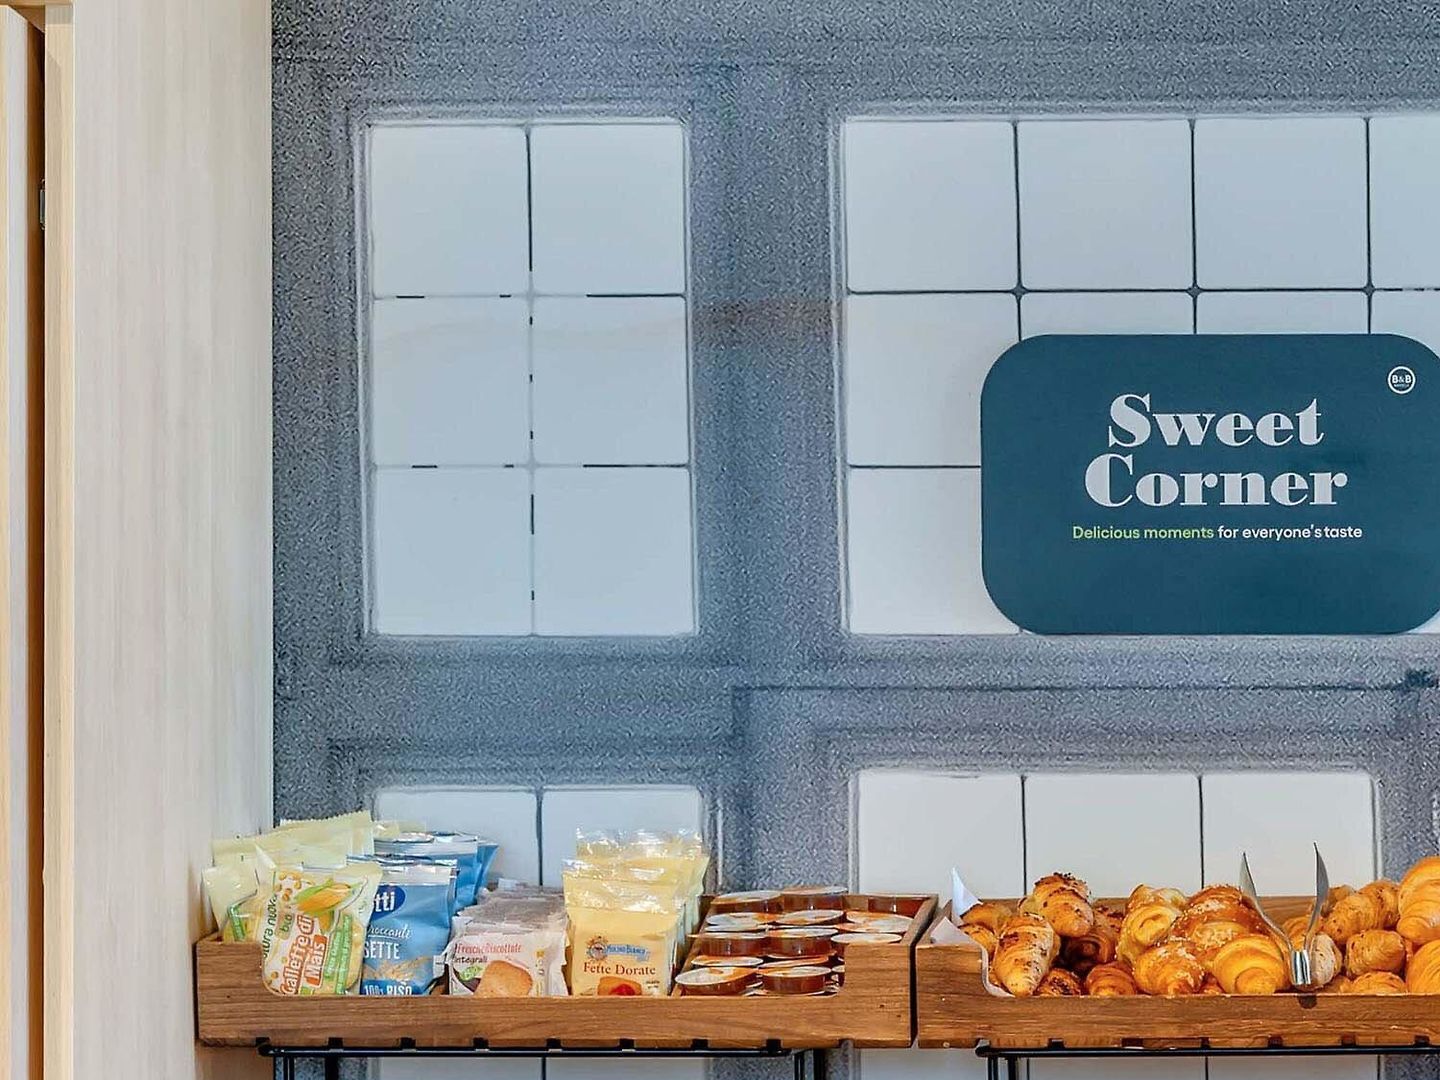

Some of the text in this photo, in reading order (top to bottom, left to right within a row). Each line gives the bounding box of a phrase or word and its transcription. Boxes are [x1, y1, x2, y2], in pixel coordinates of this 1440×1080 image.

[1392, 374, 1411, 383] B&B
[1108, 393, 1324, 448] Sweet
[1085, 453, 1348, 507] Corner
[1072, 524, 1362, 541] Delicious moments for everyone's taste
[373, 891, 396, 913] tti
[367, 923, 412, 939] roccanti
[363, 941, 400, 959] SETTE
[583, 962, 656, 975] Fette Dorate
